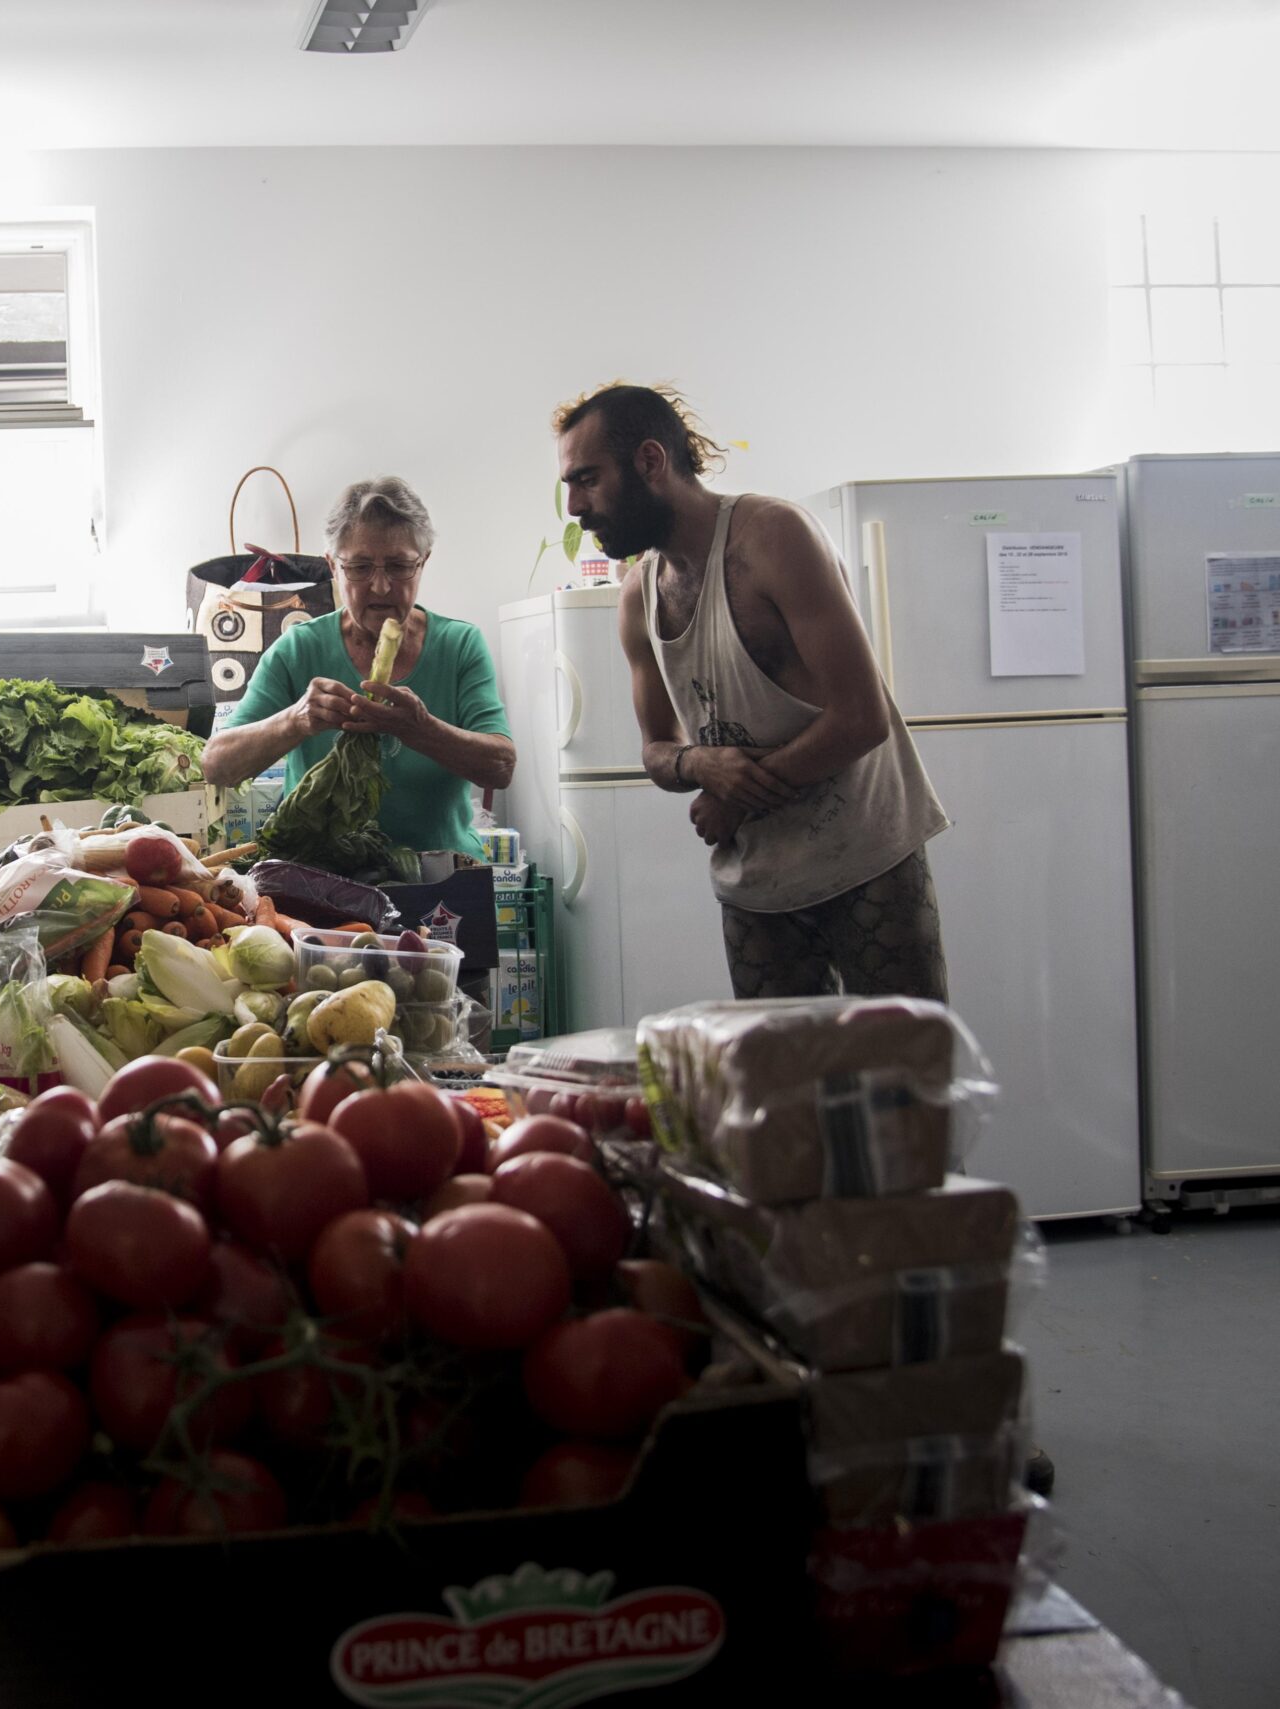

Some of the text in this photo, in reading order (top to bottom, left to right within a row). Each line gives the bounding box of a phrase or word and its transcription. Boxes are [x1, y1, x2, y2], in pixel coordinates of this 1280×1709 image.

[349, 1608, 713, 1677] PRINCE de BRETAGNE
